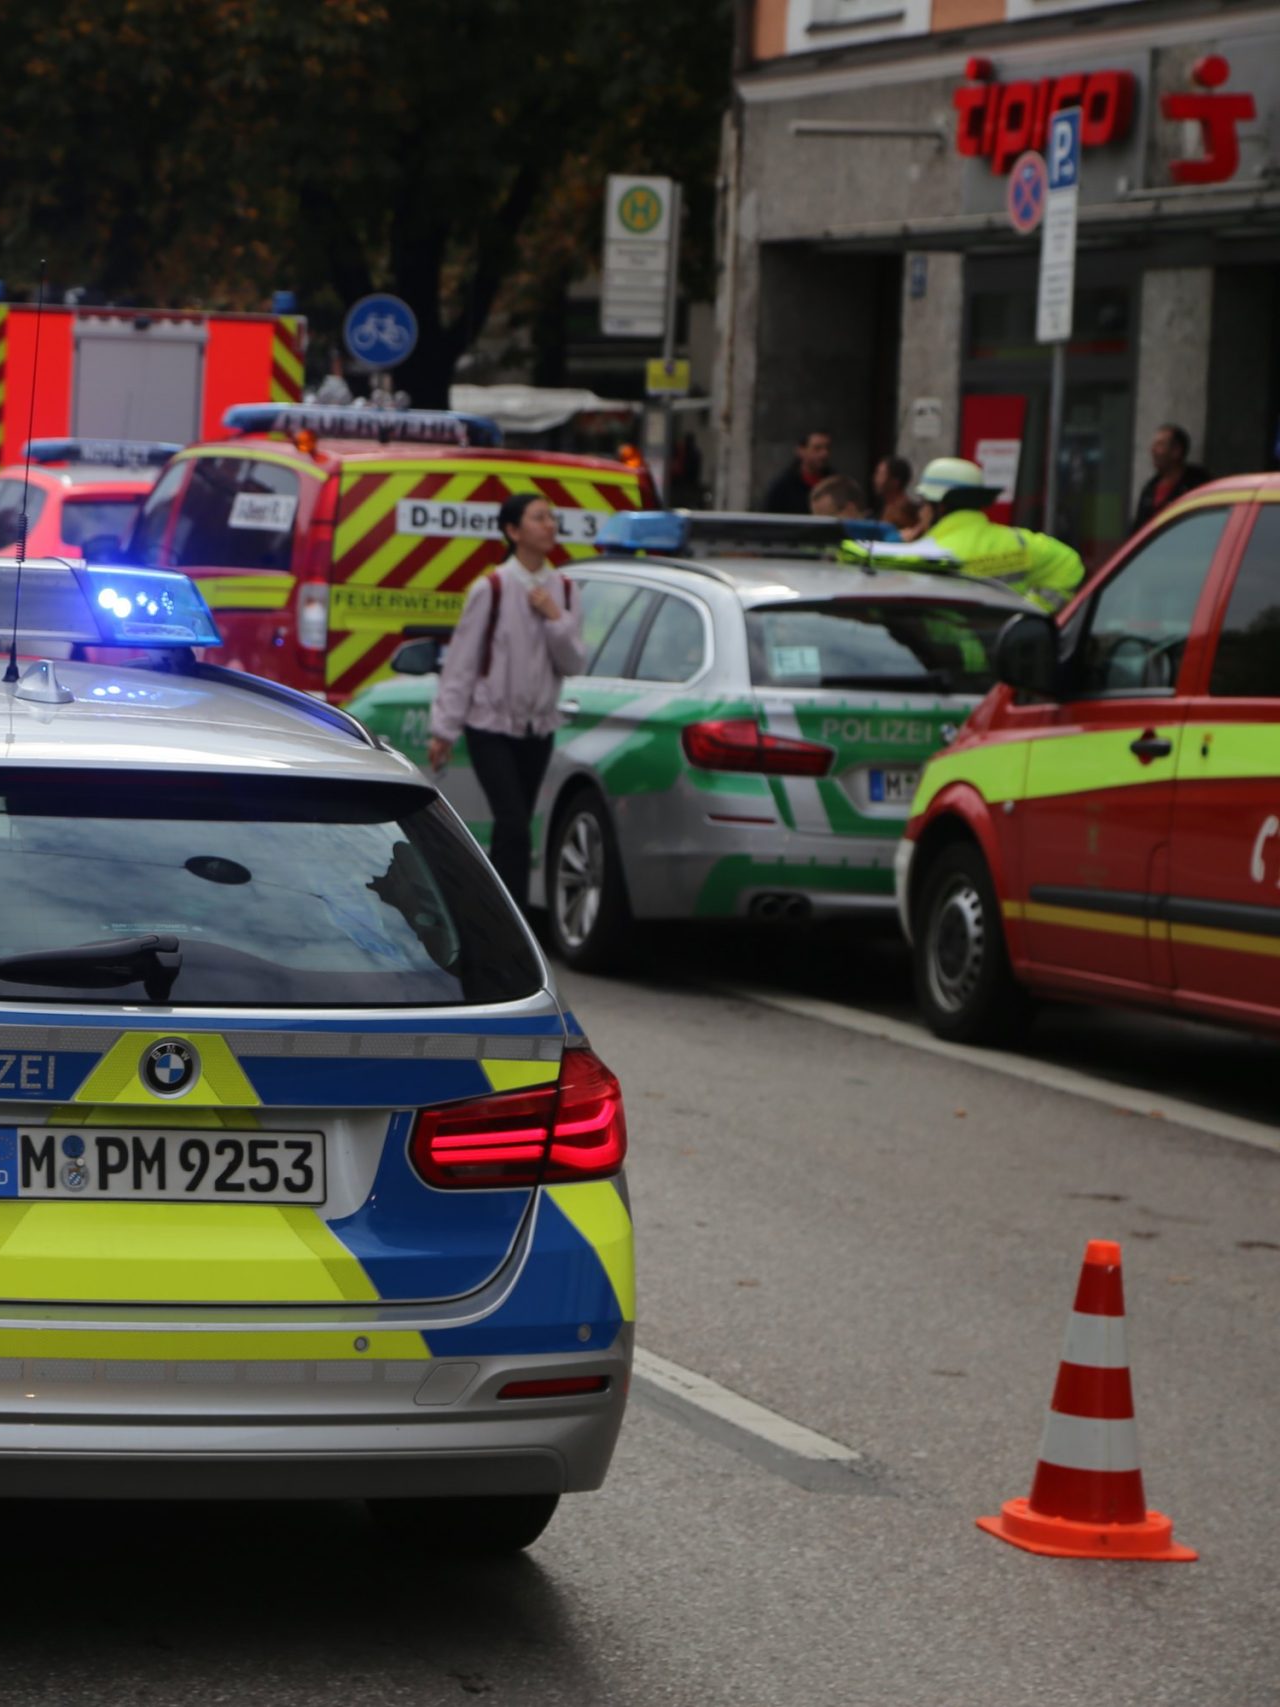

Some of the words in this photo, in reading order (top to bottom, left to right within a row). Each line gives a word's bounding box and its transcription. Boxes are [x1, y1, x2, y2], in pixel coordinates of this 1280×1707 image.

[1052, 119, 1072, 183] P
[411, 506, 501, 532] D-Dien
[583, 513, 597, 538] 3
[822, 717, 932, 744] POLIZEI
[151, 1044, 190, 1061] BMW
[21, 1135, 55, 1189] M
[96, 1136, 167, 1191] PM
[179, 1138, 315, 1194] 9253
